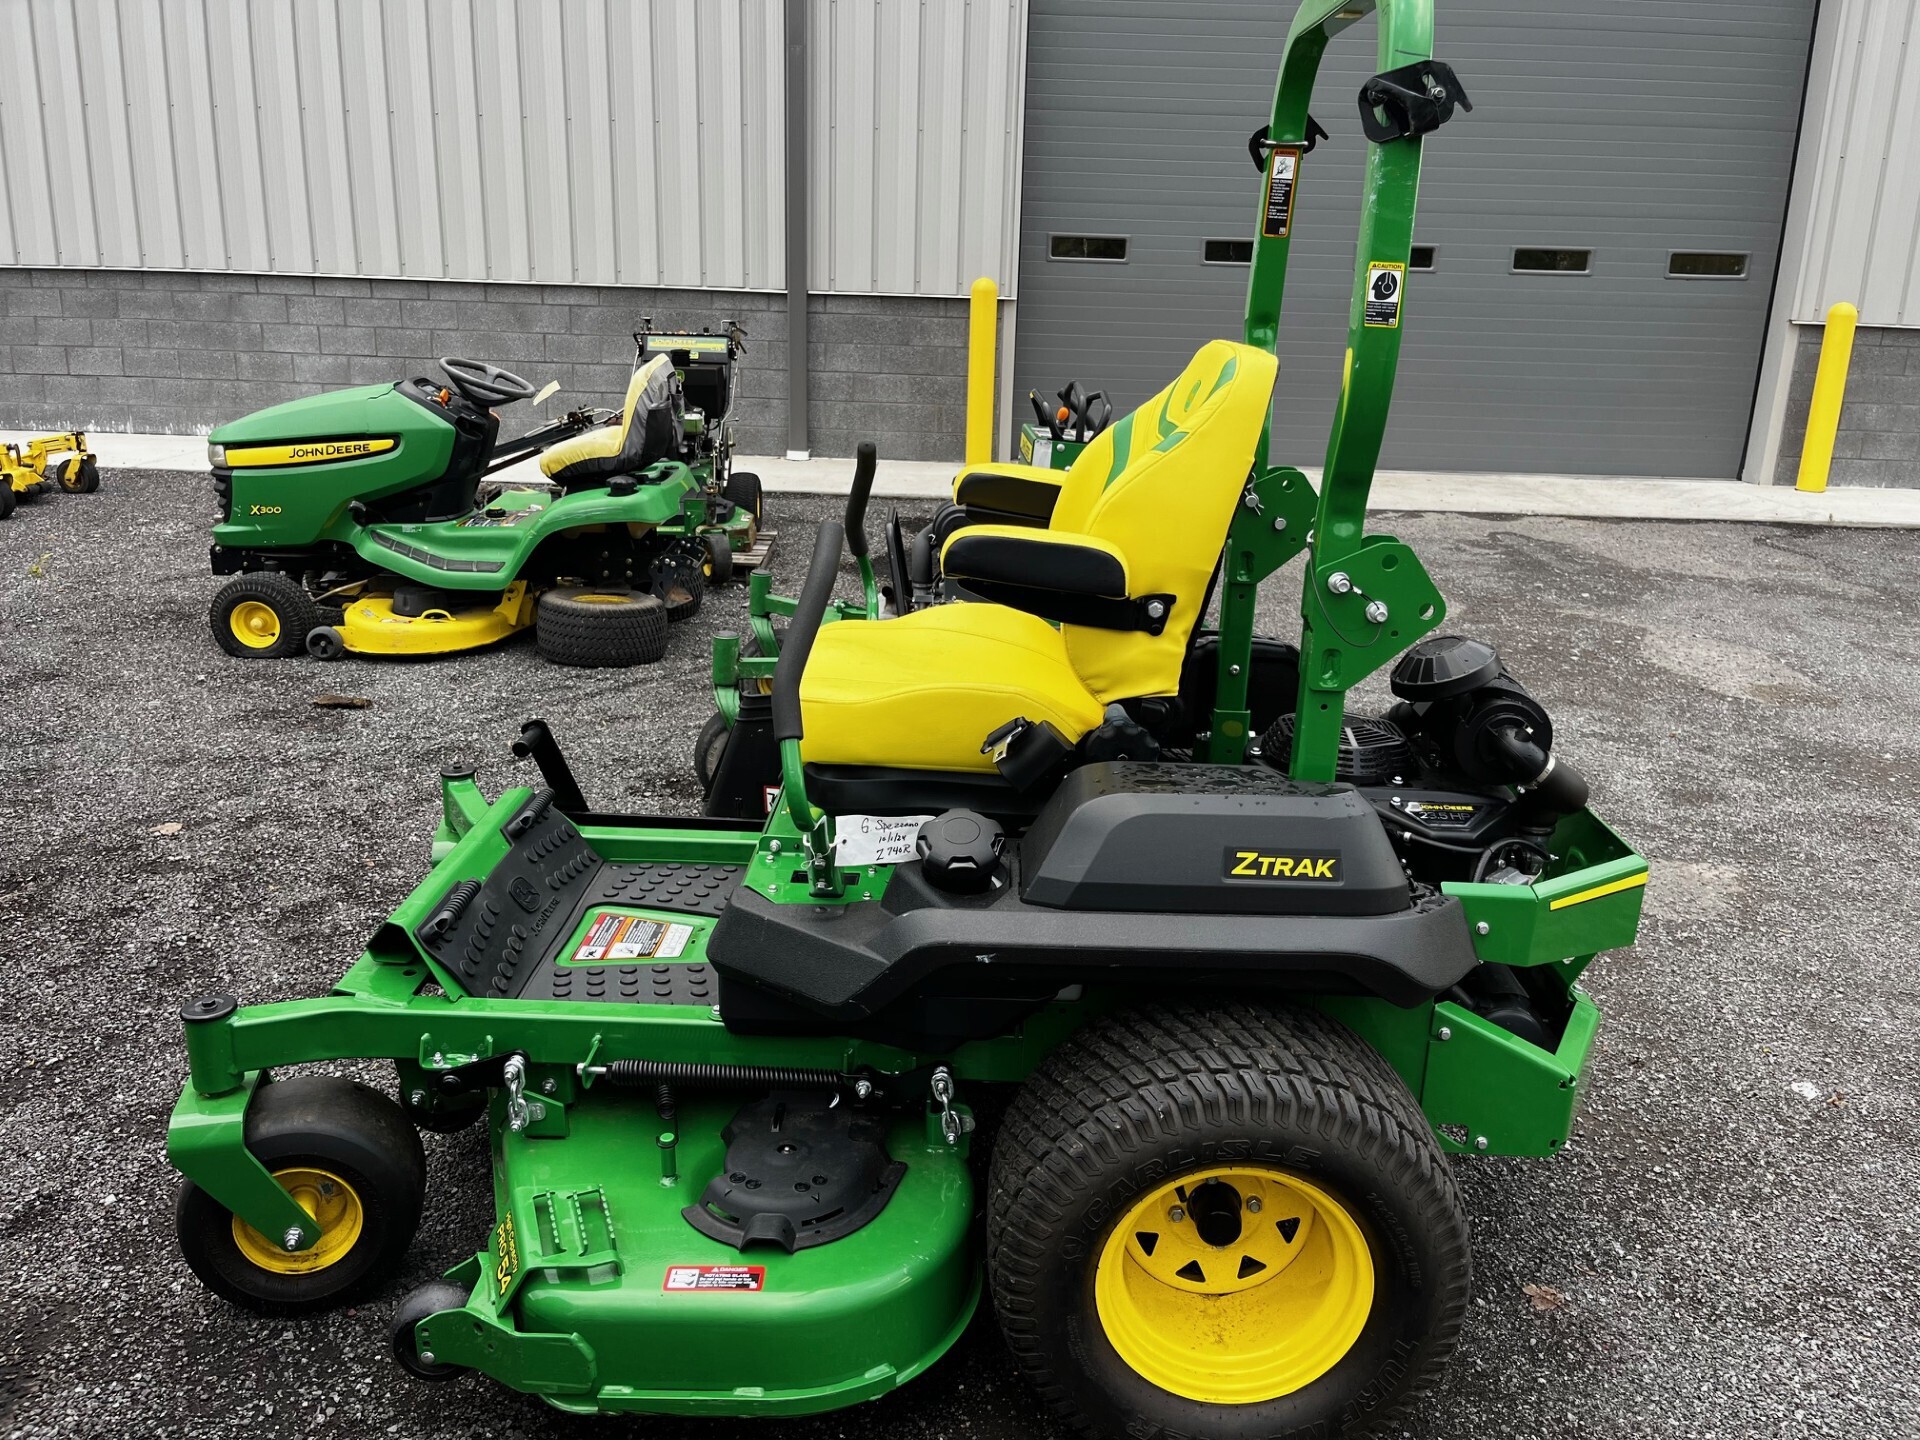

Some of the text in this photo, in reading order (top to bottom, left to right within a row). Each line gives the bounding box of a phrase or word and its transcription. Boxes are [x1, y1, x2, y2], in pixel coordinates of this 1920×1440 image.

[289, 443, 371, 459] JOHN DEERE
[250, 504, 282, 516] X300
[875, 819, 919, 831] Spezzano
[1420, 811, 1471, 820] 23.5 HP
[1231, 851, 1337, 878] ZTRAK
[1079, 1139, 1322, 1231] CARLISLE
[497, 1223, 512, 1296] PRO 54
[1340, 1338, 1421, 1434] TURF
